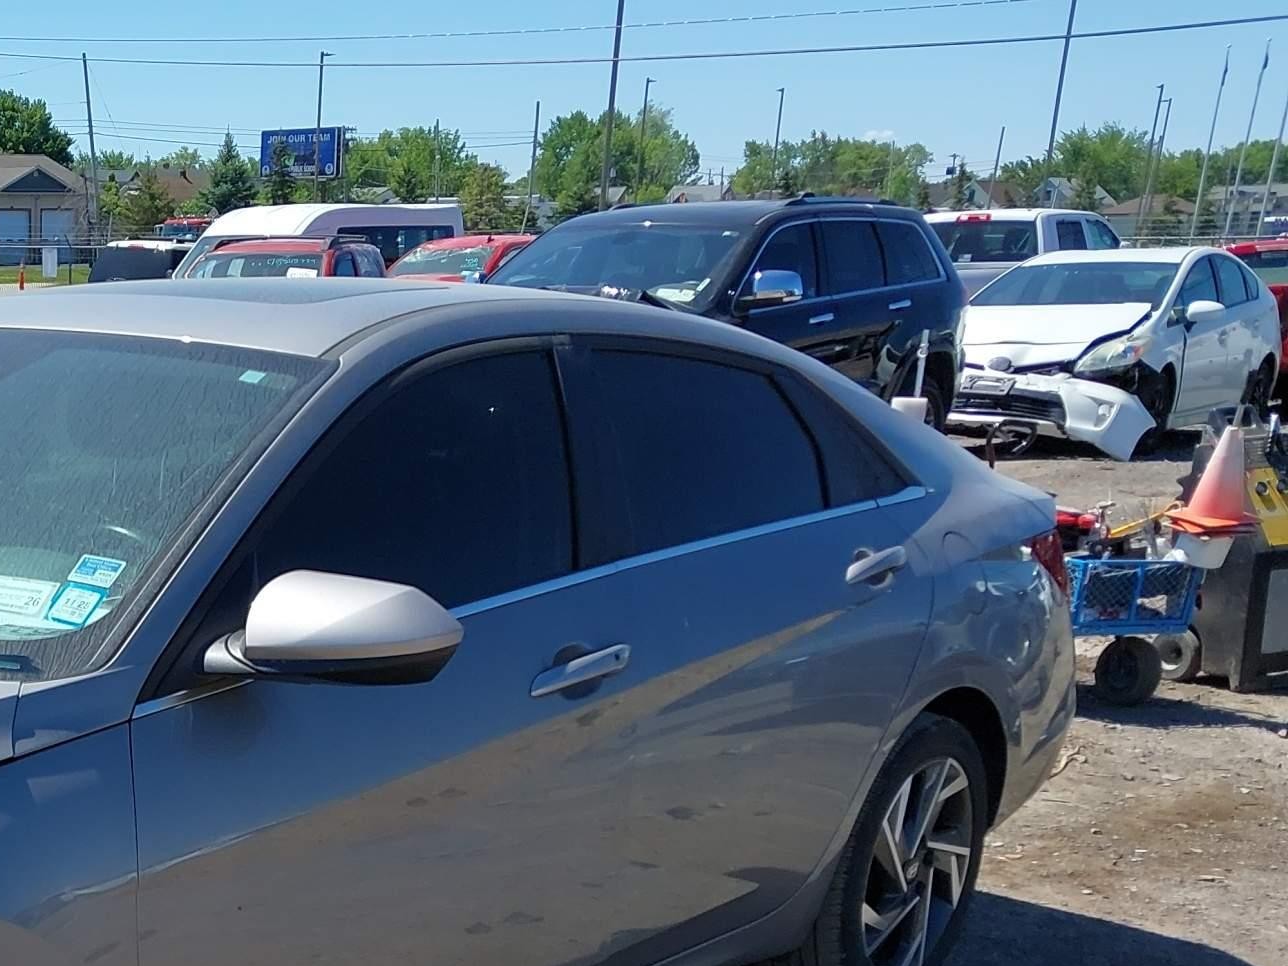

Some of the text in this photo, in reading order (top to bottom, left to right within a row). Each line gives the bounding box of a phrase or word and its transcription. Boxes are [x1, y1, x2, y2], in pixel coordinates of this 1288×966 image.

[267, 133, 331, 144] JOIN OUR TEAM
[23, 595, 41, 607] 26
